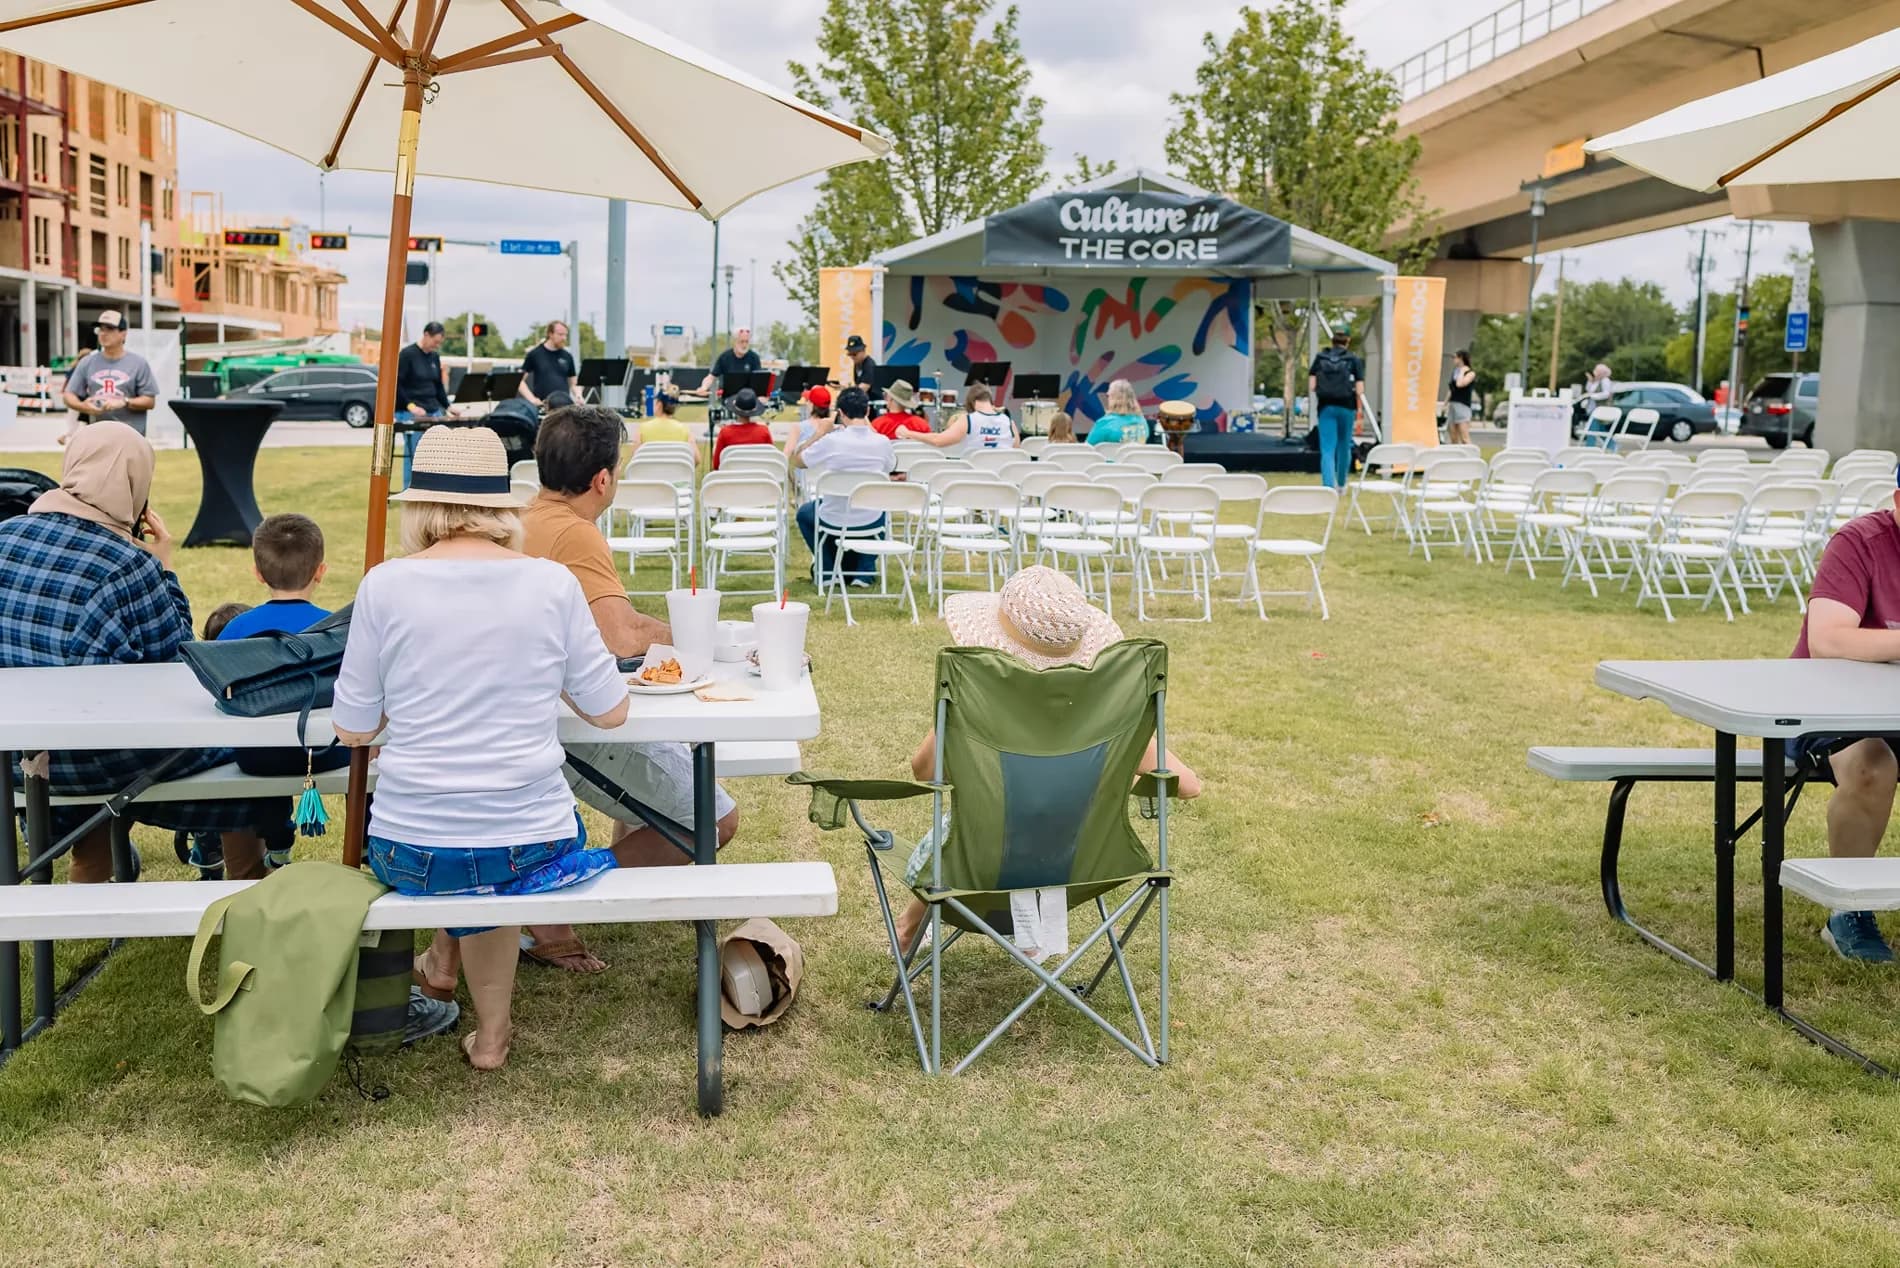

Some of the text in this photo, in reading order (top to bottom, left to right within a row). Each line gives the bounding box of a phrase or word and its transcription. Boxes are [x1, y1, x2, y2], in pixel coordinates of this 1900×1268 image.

[1060, 196, 1220, 233] Culture in
[1059, 237, 1219, 261] THE CORE
[1407, 279, 1428, 411] DOWNTOWN
